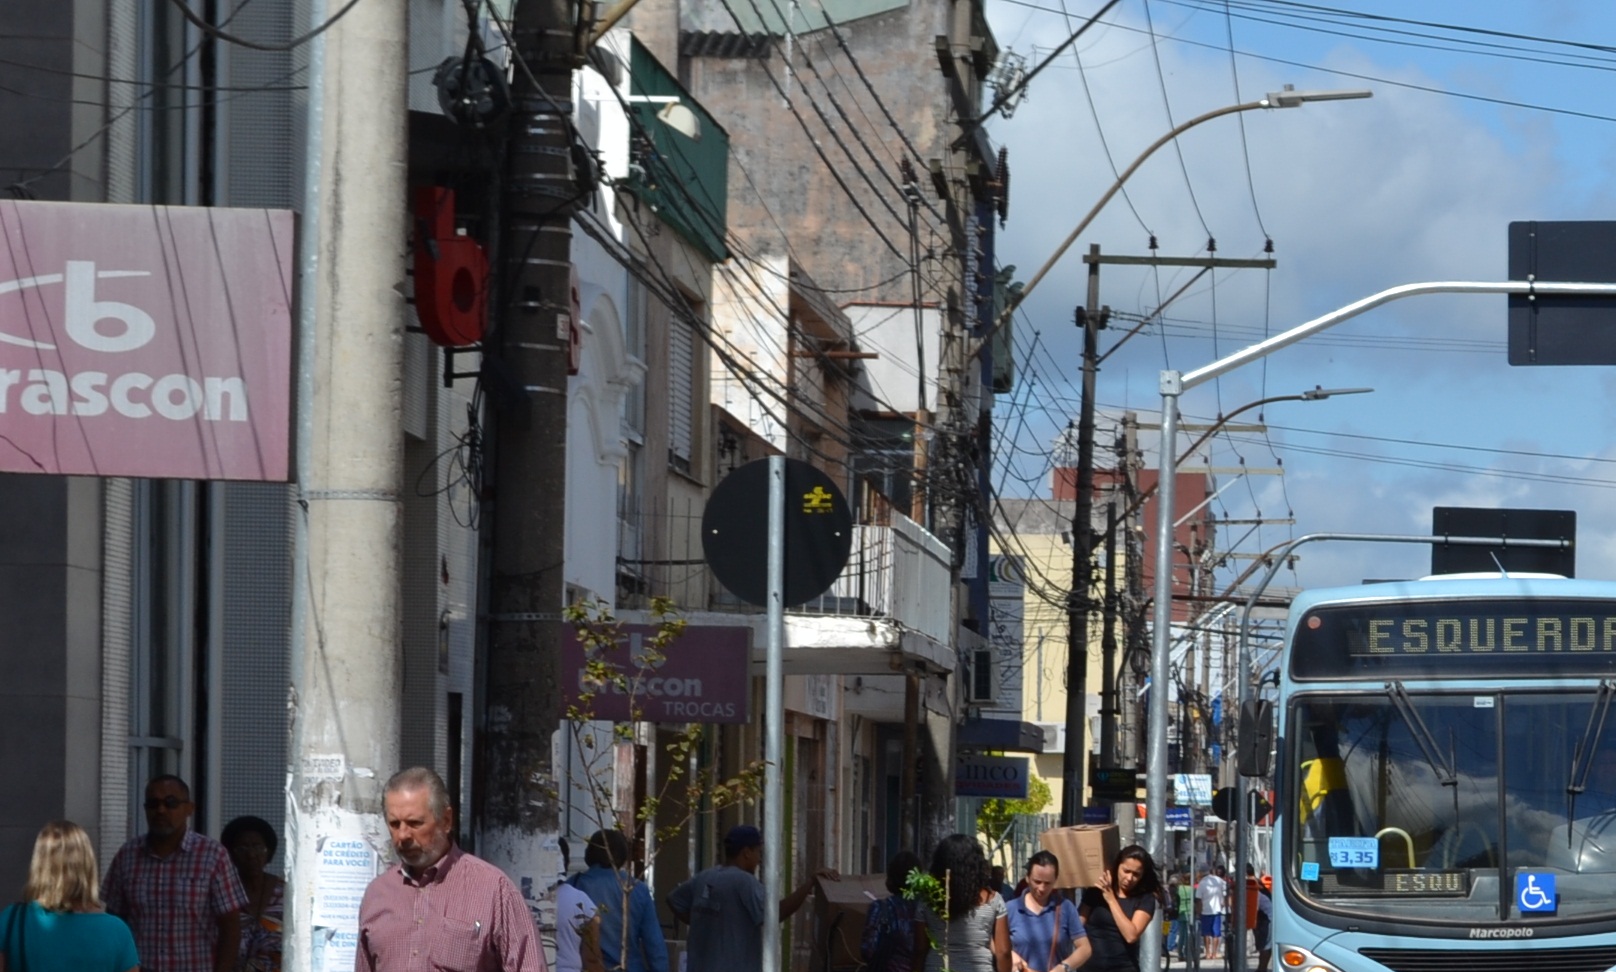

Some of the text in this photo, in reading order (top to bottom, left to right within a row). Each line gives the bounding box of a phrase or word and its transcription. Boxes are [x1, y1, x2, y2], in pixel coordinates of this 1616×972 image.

[663, 701, 736, 718] TROCAS
[959, 757, 1018, 781] inco
[330, 840, 363, 849] CARTÃO
[335, 849, 370, 858] CRÉDITO
[1339, 851, 1374, 864] 3,35
[1396, 873, 1459, 891] ESQU
[1469, 927, 1534, 939] Marcopolo
